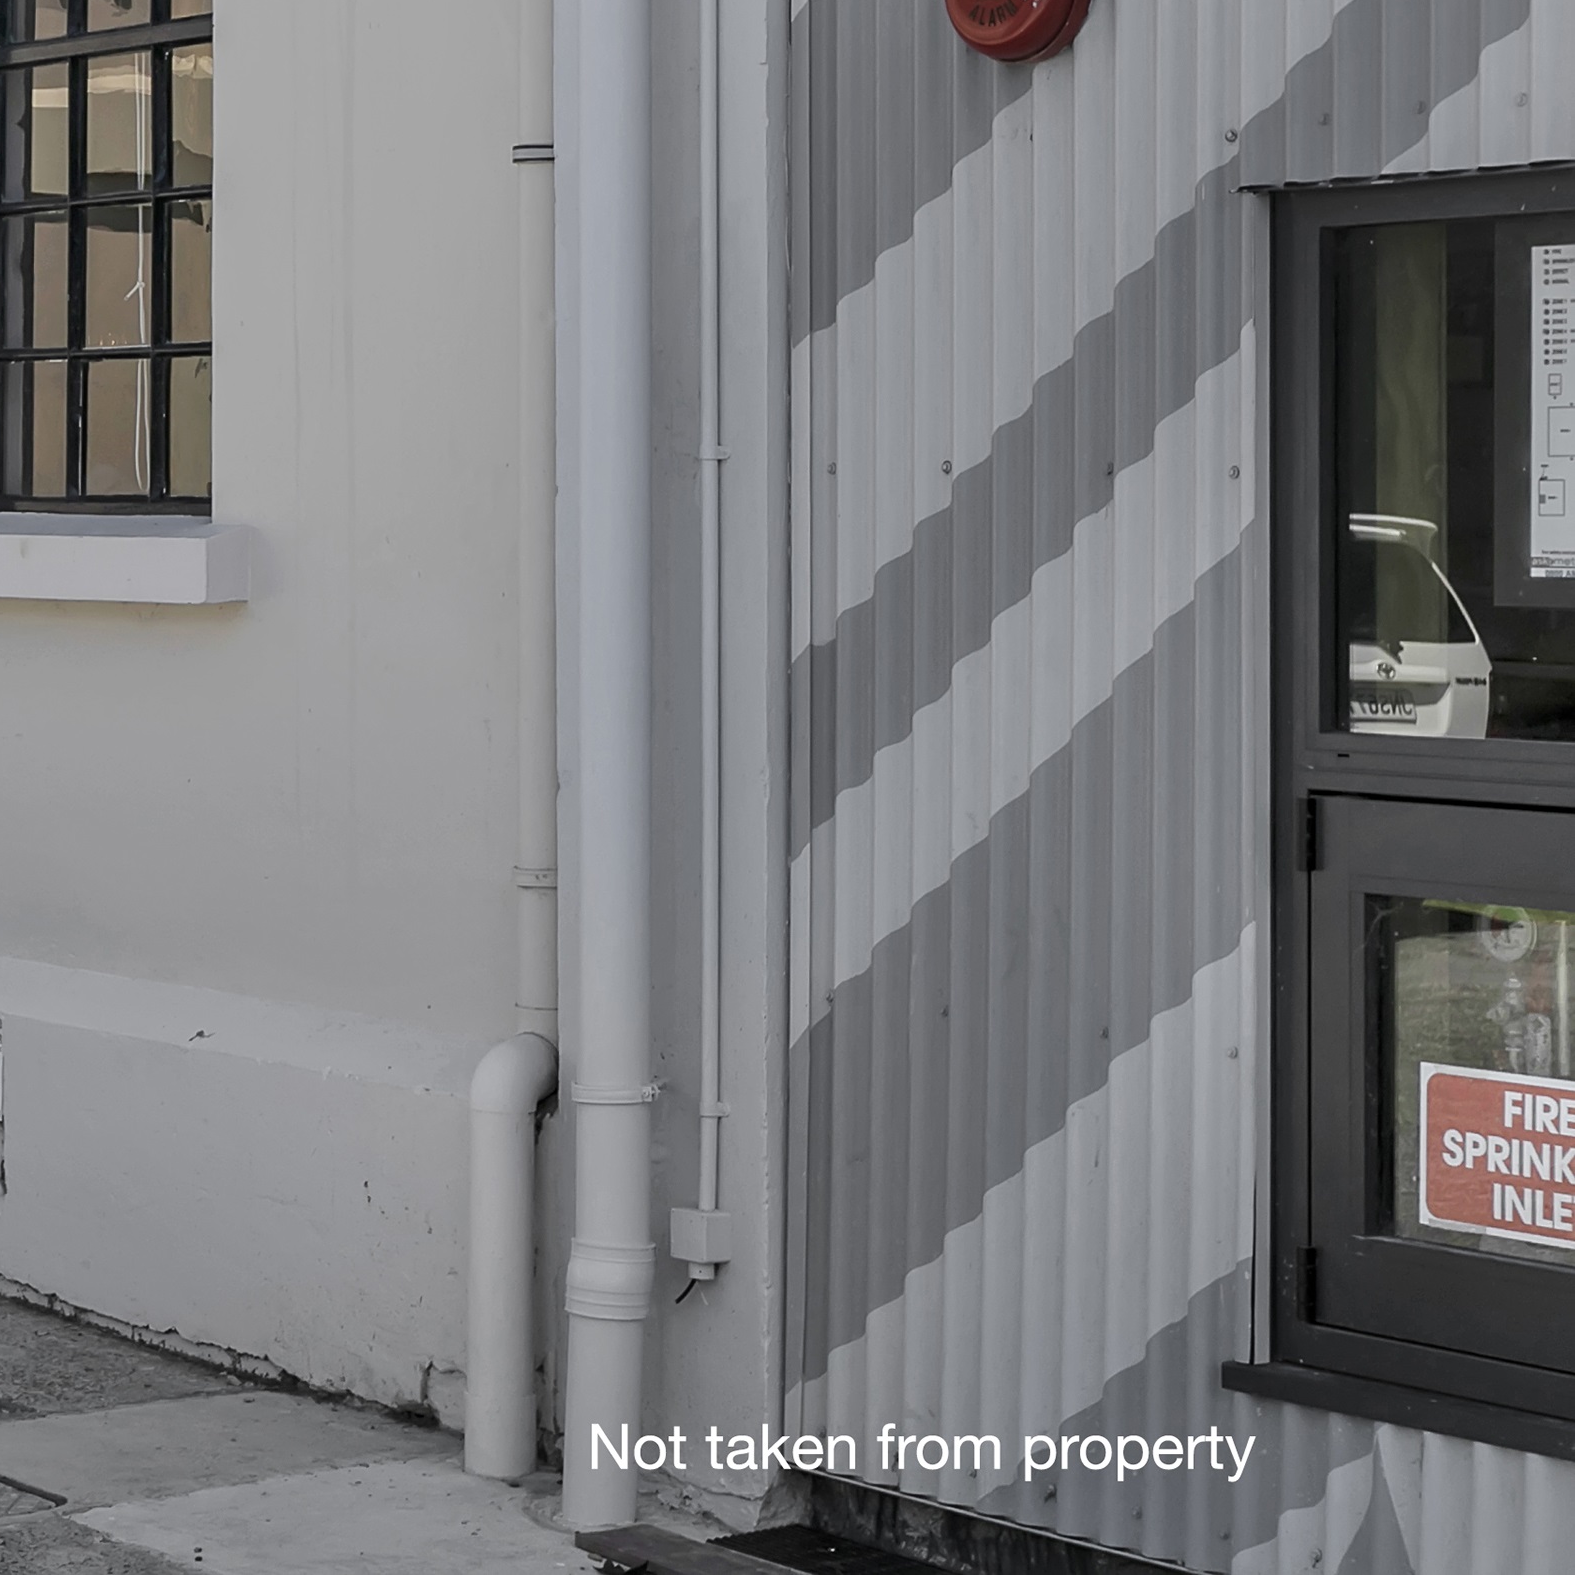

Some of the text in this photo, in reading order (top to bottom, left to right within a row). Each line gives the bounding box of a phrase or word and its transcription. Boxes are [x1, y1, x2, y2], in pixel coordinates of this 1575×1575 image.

[969, 0, 1018, 27] ALARM
[1504, 1090, 1575, 1137] FIRE
[1493, 1183, 1575, 1232] INLE
